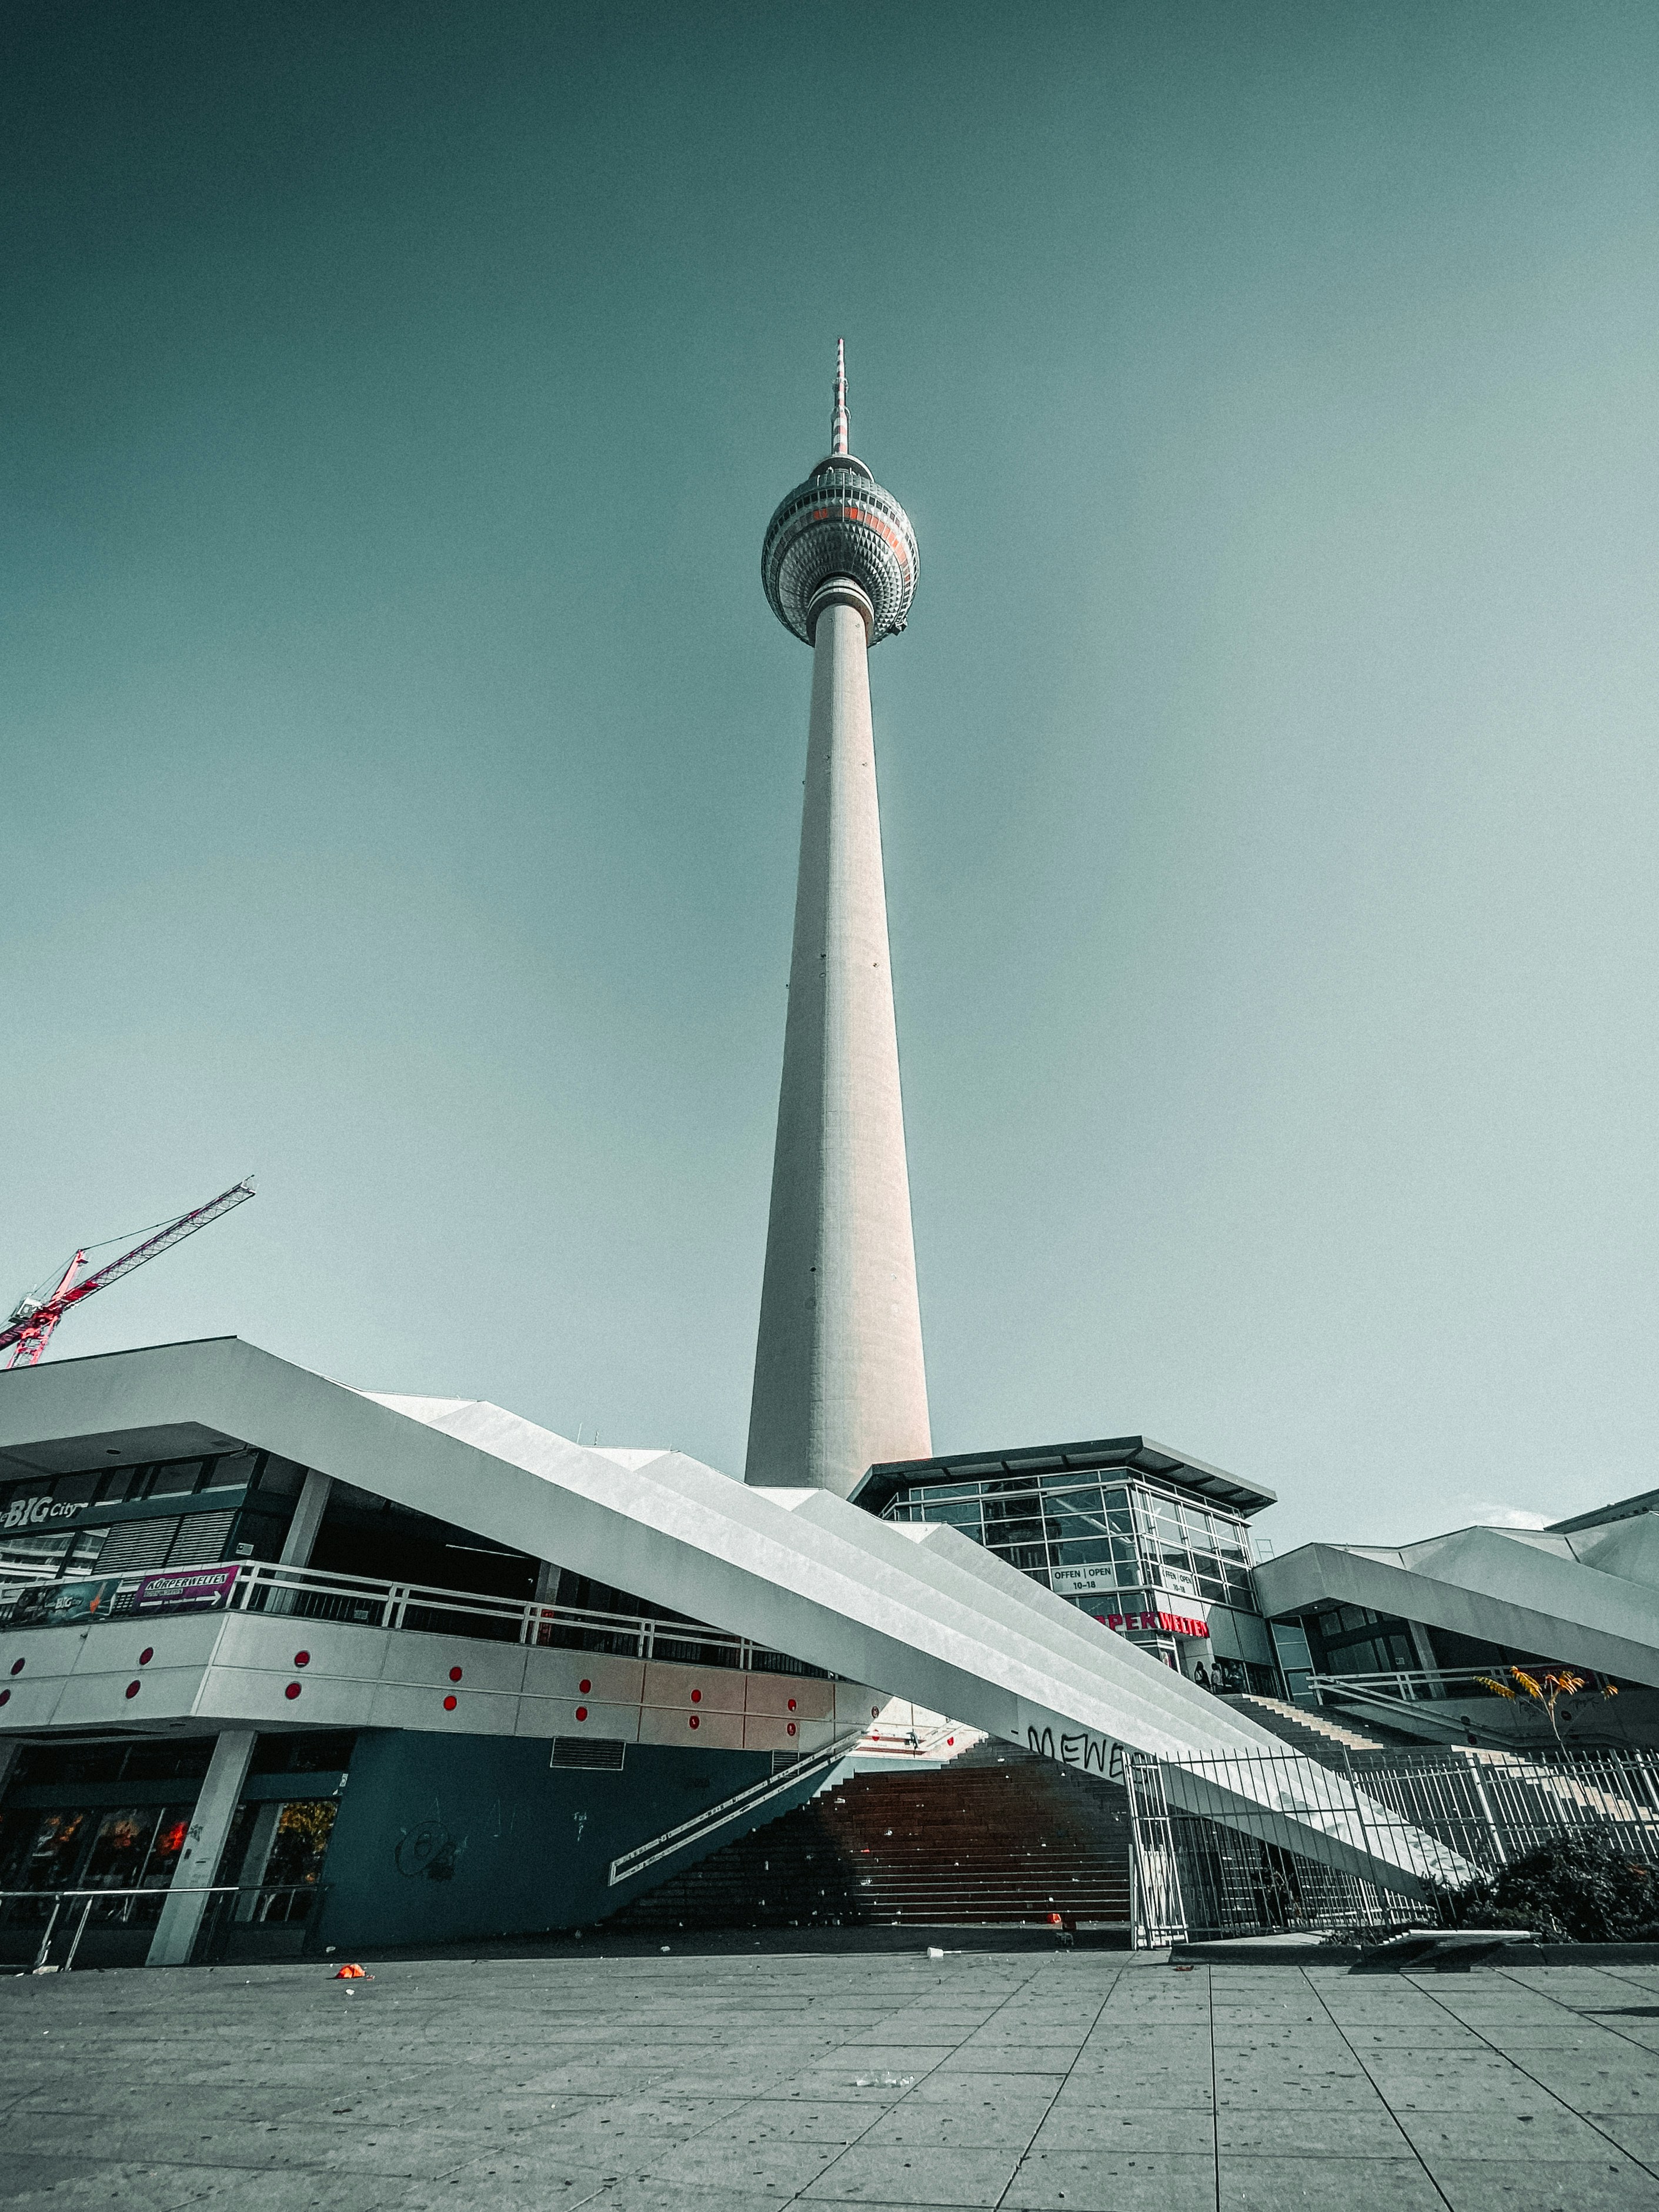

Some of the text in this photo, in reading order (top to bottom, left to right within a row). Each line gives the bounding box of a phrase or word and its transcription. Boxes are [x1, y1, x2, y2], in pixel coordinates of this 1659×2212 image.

[4, 1497, 53, 1527] BIG
[50, 1502, 88, 1517] City
[1054, 1567, 1111, 1579] OFFEN OPEN
[1180, 1574, 1192, 1584] OPEN
[146, 1574, 226, 1589] KÖRPERWELTEN
[1073, 1581, 1096, 1589] 10-18
[1158, 1612, 1210, 1638] WELTEN
